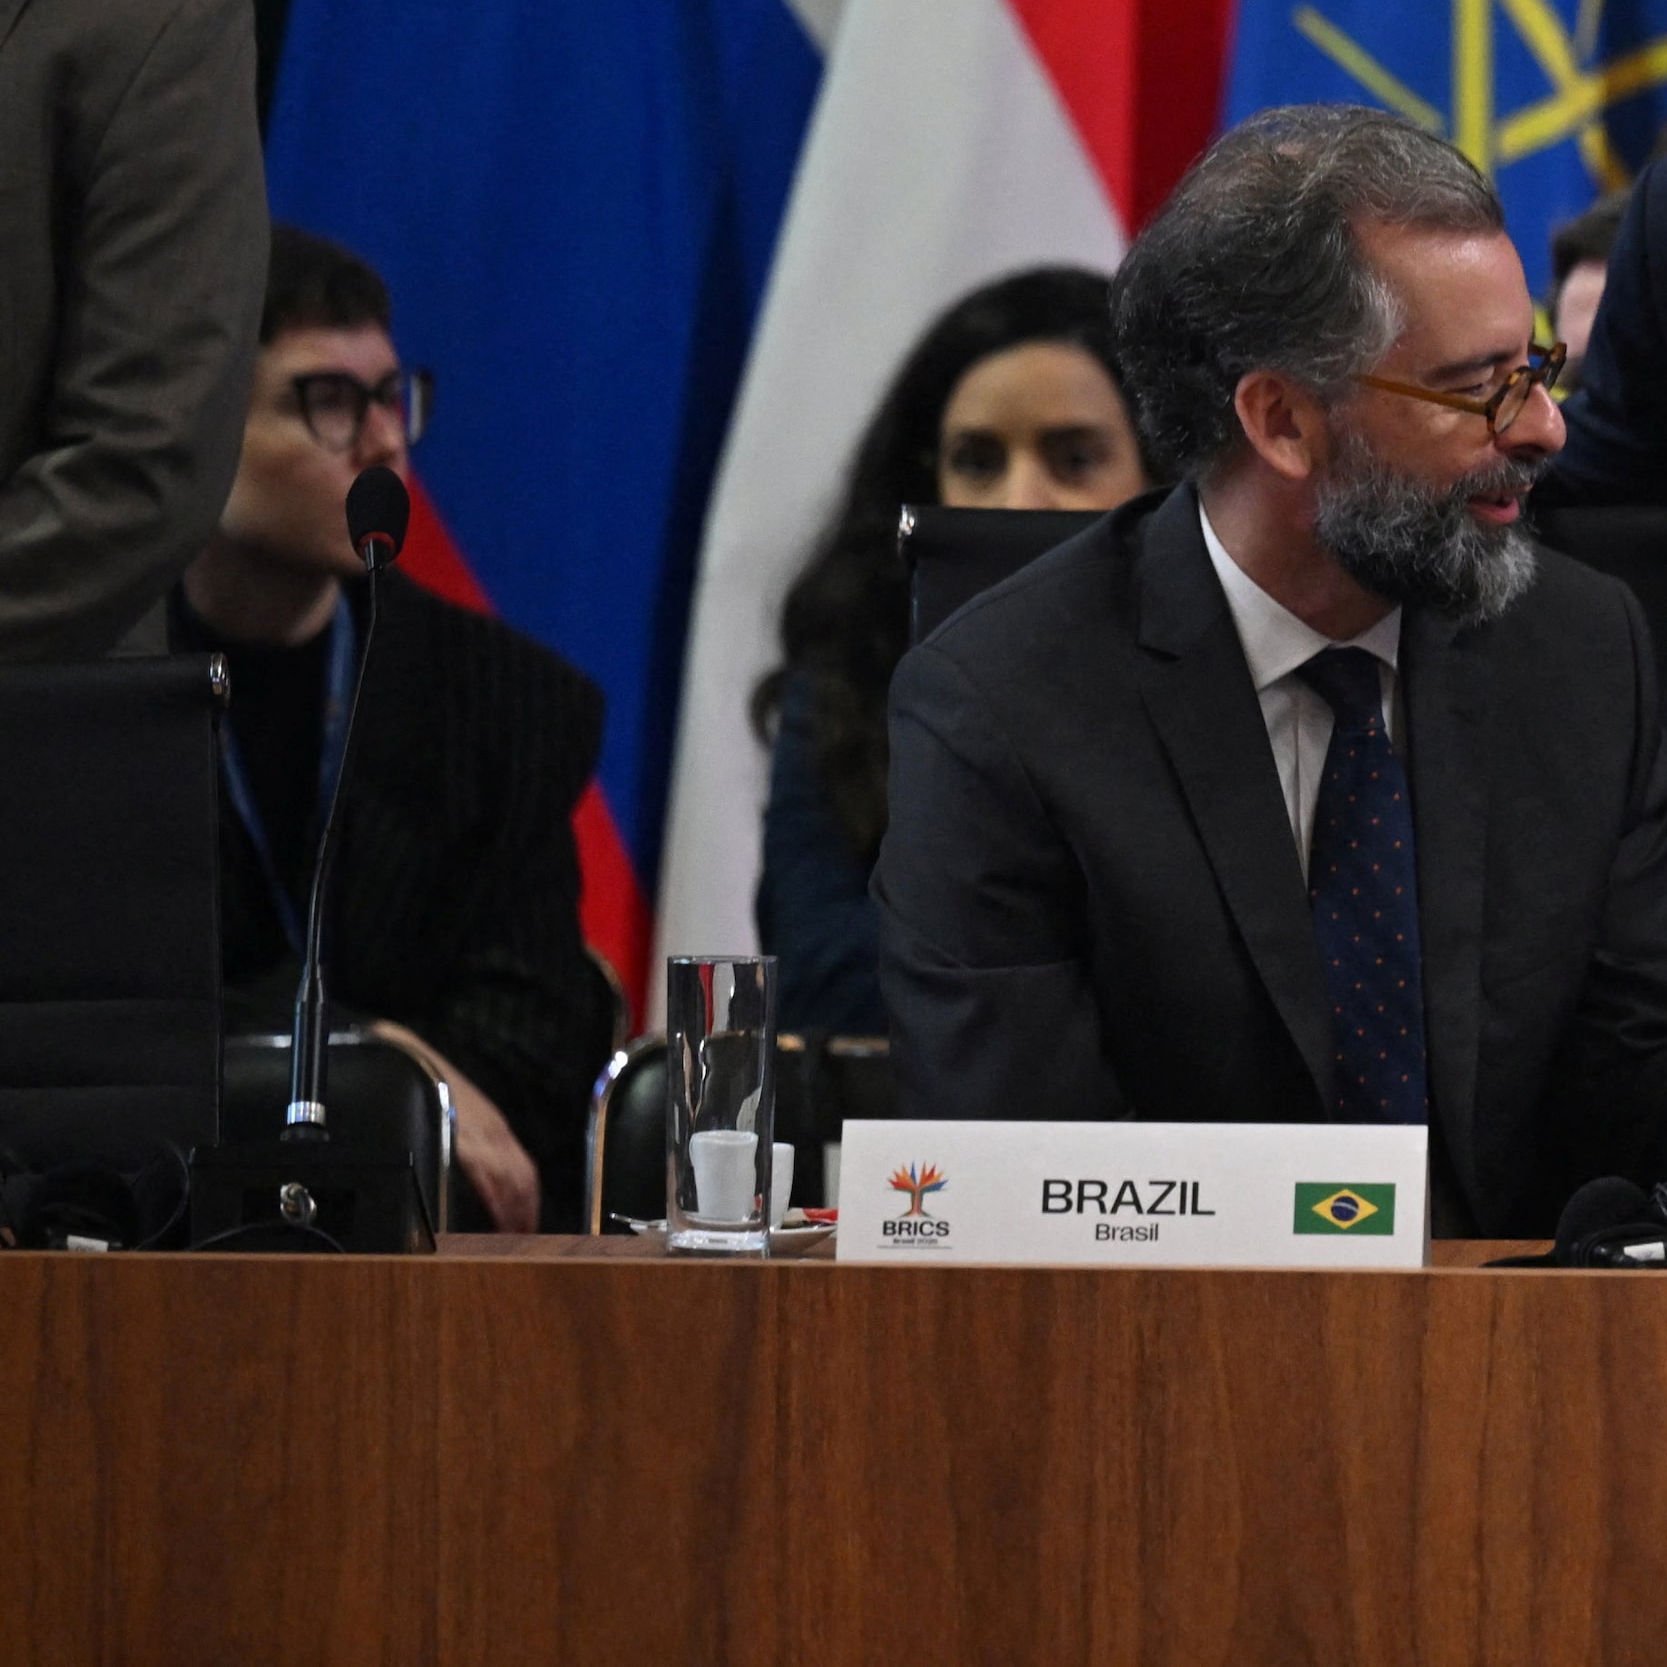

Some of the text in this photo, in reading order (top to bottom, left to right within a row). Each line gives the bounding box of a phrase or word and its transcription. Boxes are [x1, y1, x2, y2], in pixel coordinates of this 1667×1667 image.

[1041, 1179, 1216, 1217] BRAZIL
[882, 1220, 950, 1237] BRICS
[1095, 1223, 1160, 1242] Brasil
